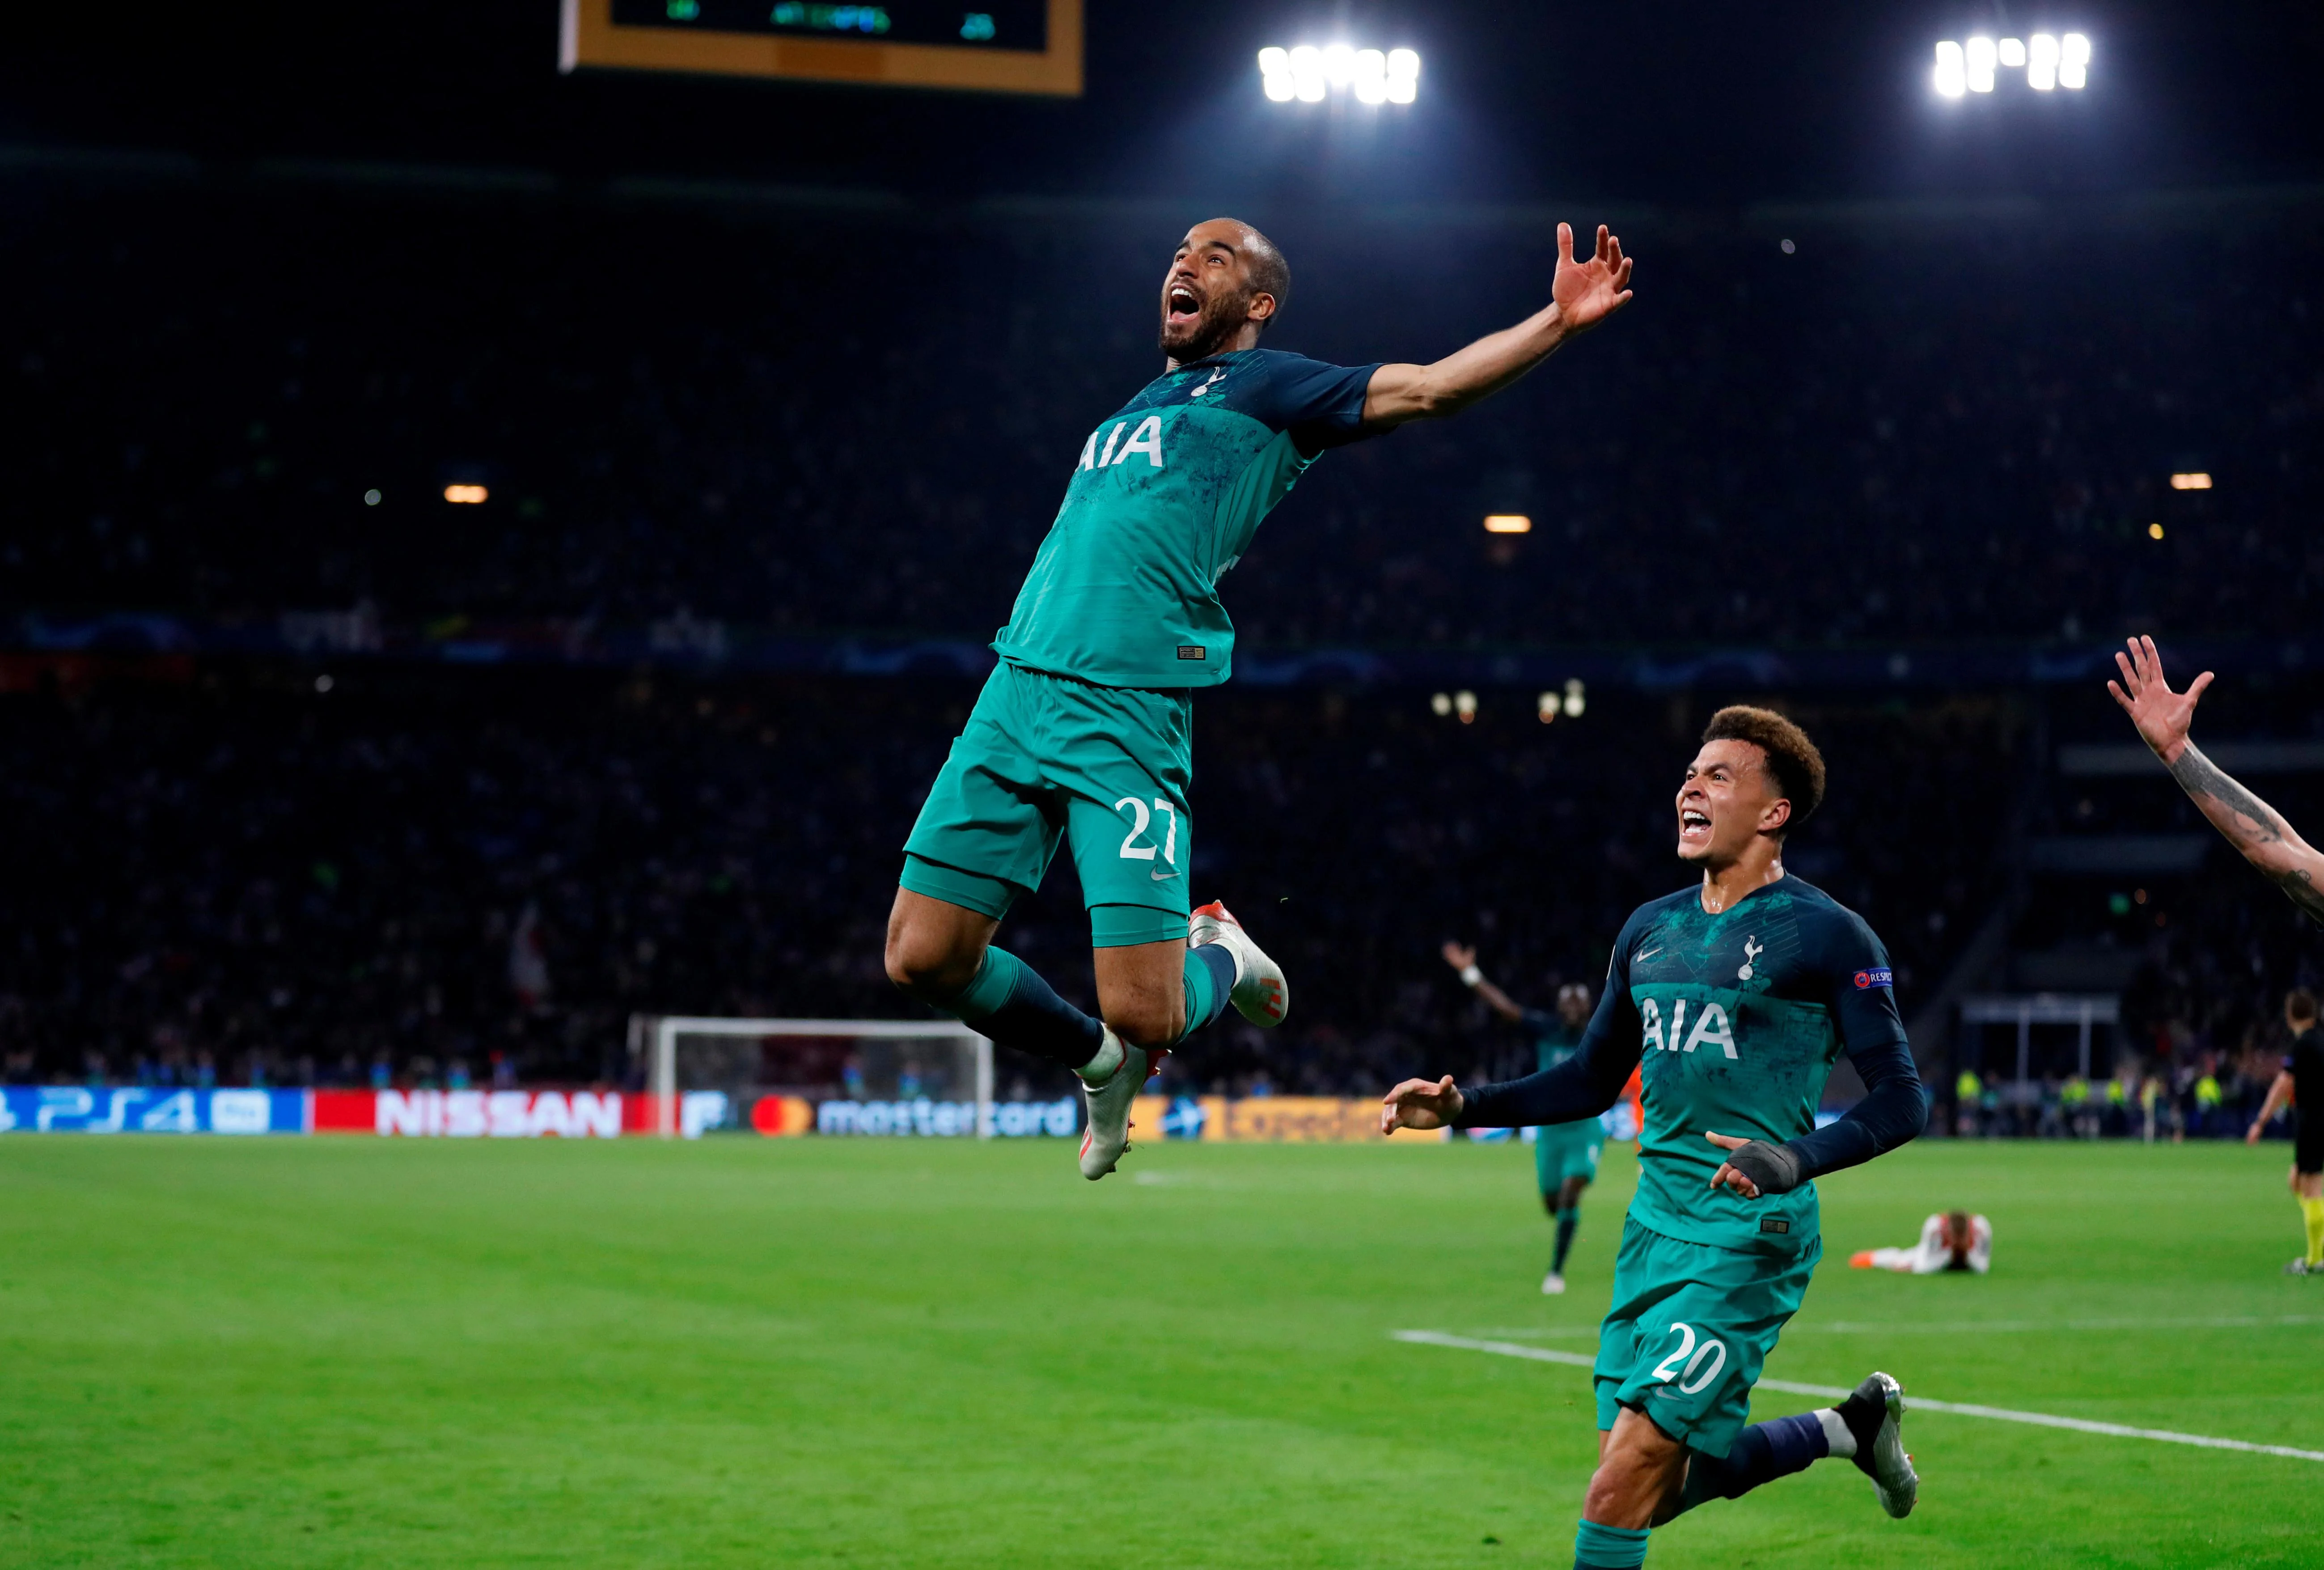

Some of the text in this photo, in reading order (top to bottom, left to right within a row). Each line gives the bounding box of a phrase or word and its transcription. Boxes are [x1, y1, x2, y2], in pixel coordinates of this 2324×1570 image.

[1115, 797, 1176, 865] 27
[1642, 997, 1739, 1060] AIA
[376, 1090, 622, 1137] NISSAN
[1651, 1322, 1727, 1394] 20
